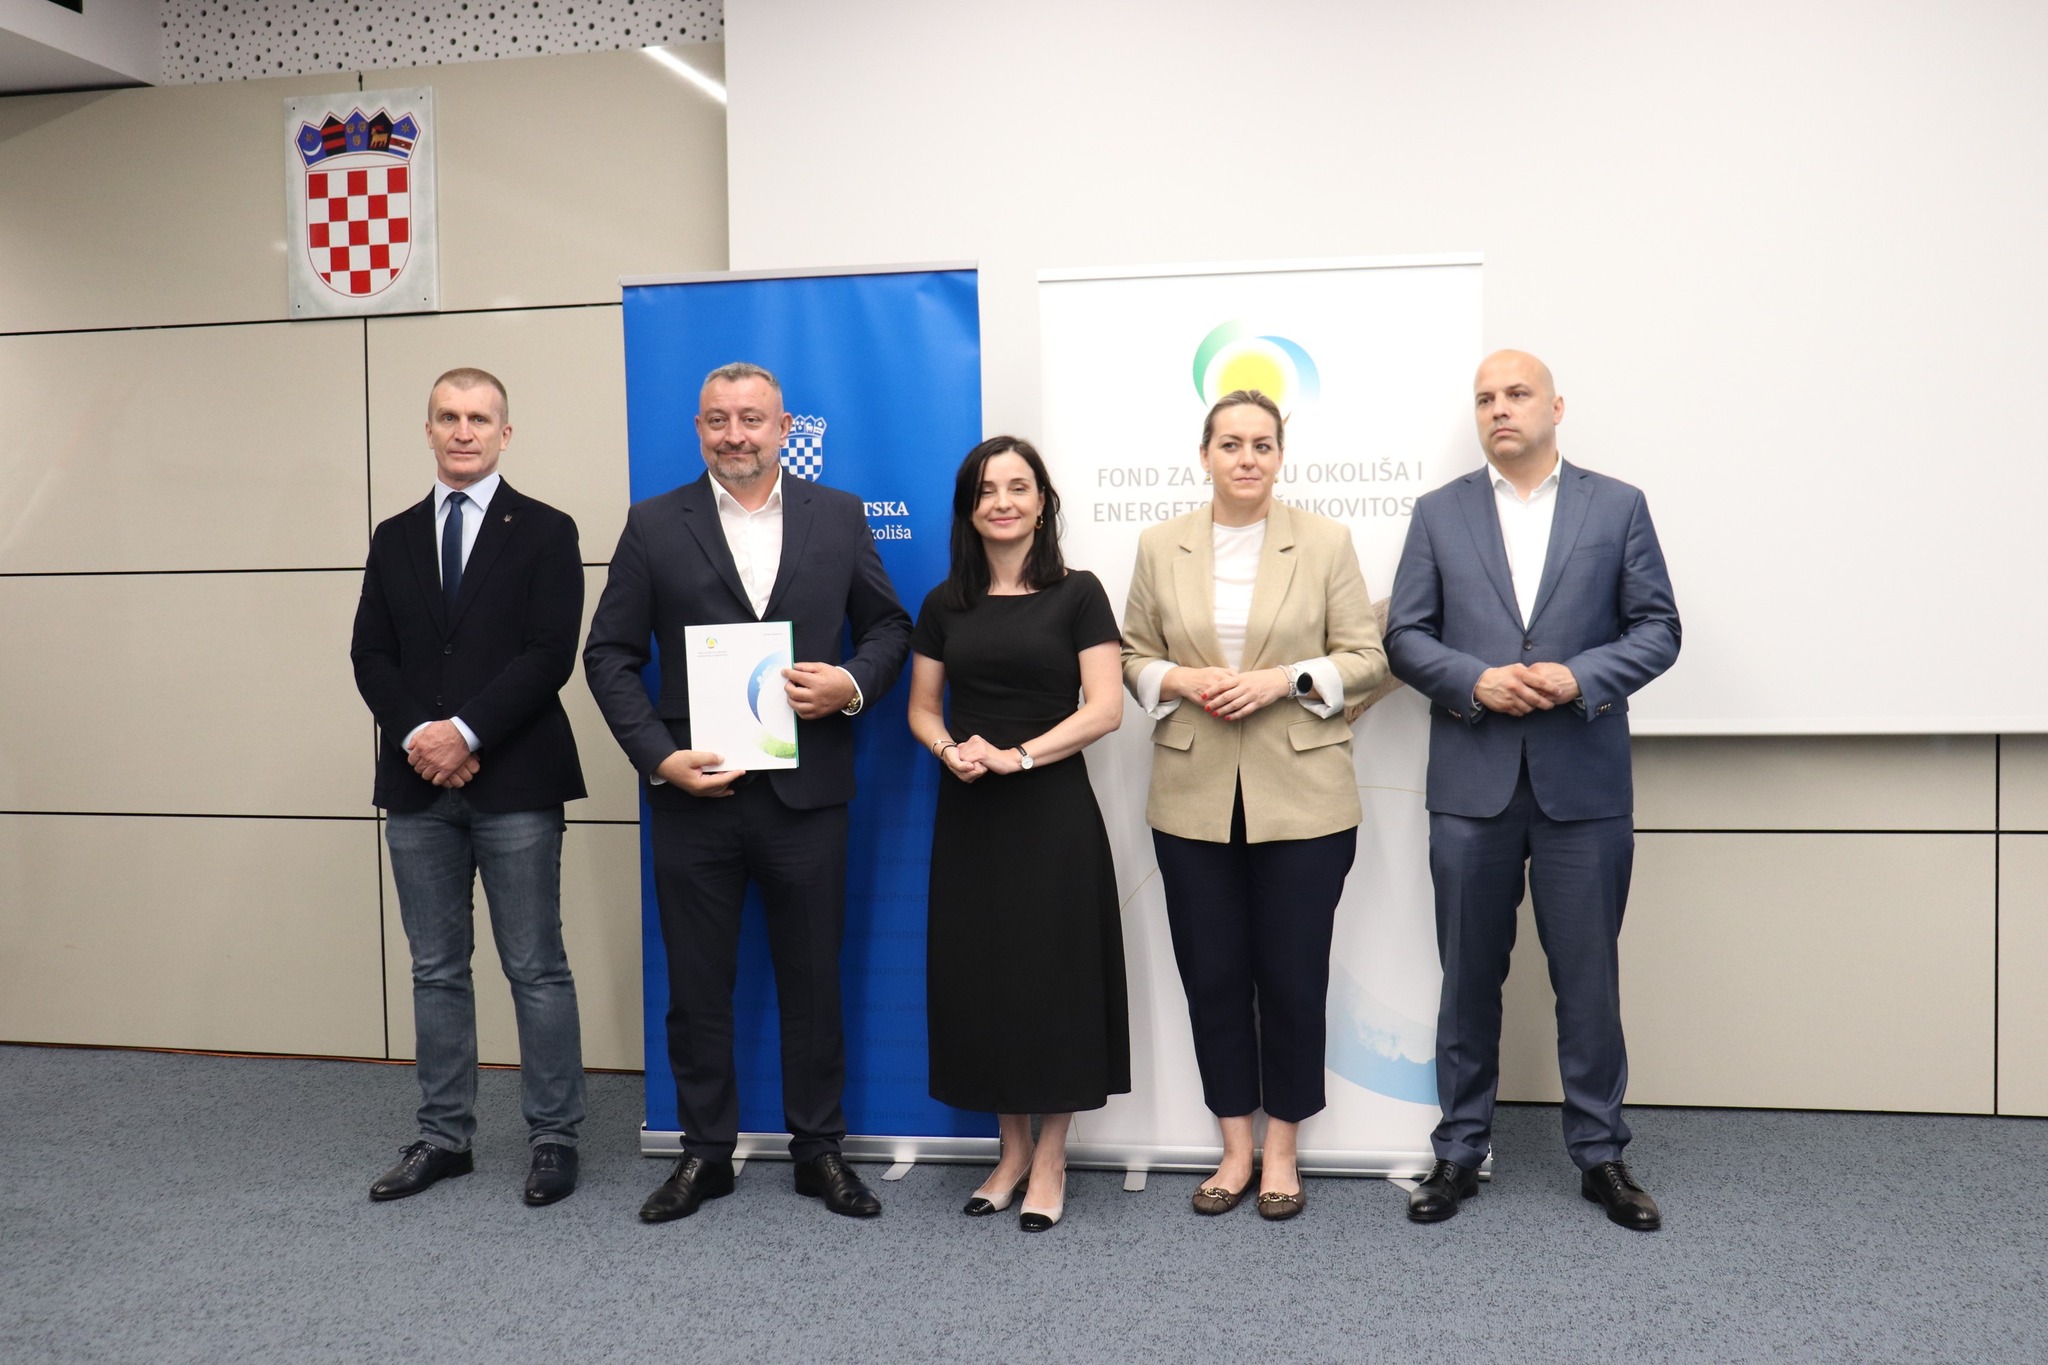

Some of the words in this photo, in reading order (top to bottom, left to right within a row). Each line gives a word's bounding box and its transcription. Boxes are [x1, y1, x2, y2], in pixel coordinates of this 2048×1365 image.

[1098, 467, 1160, 488] FOND
[1167, 466, 1196, 487] ZA
[1306, 457, 1410, 483] OKOLIŠA
[1417, 461, 1422, 481] I
[863, 501, 910, 517] TSKA
[1093, 500, 1211, 522] ENERGET
